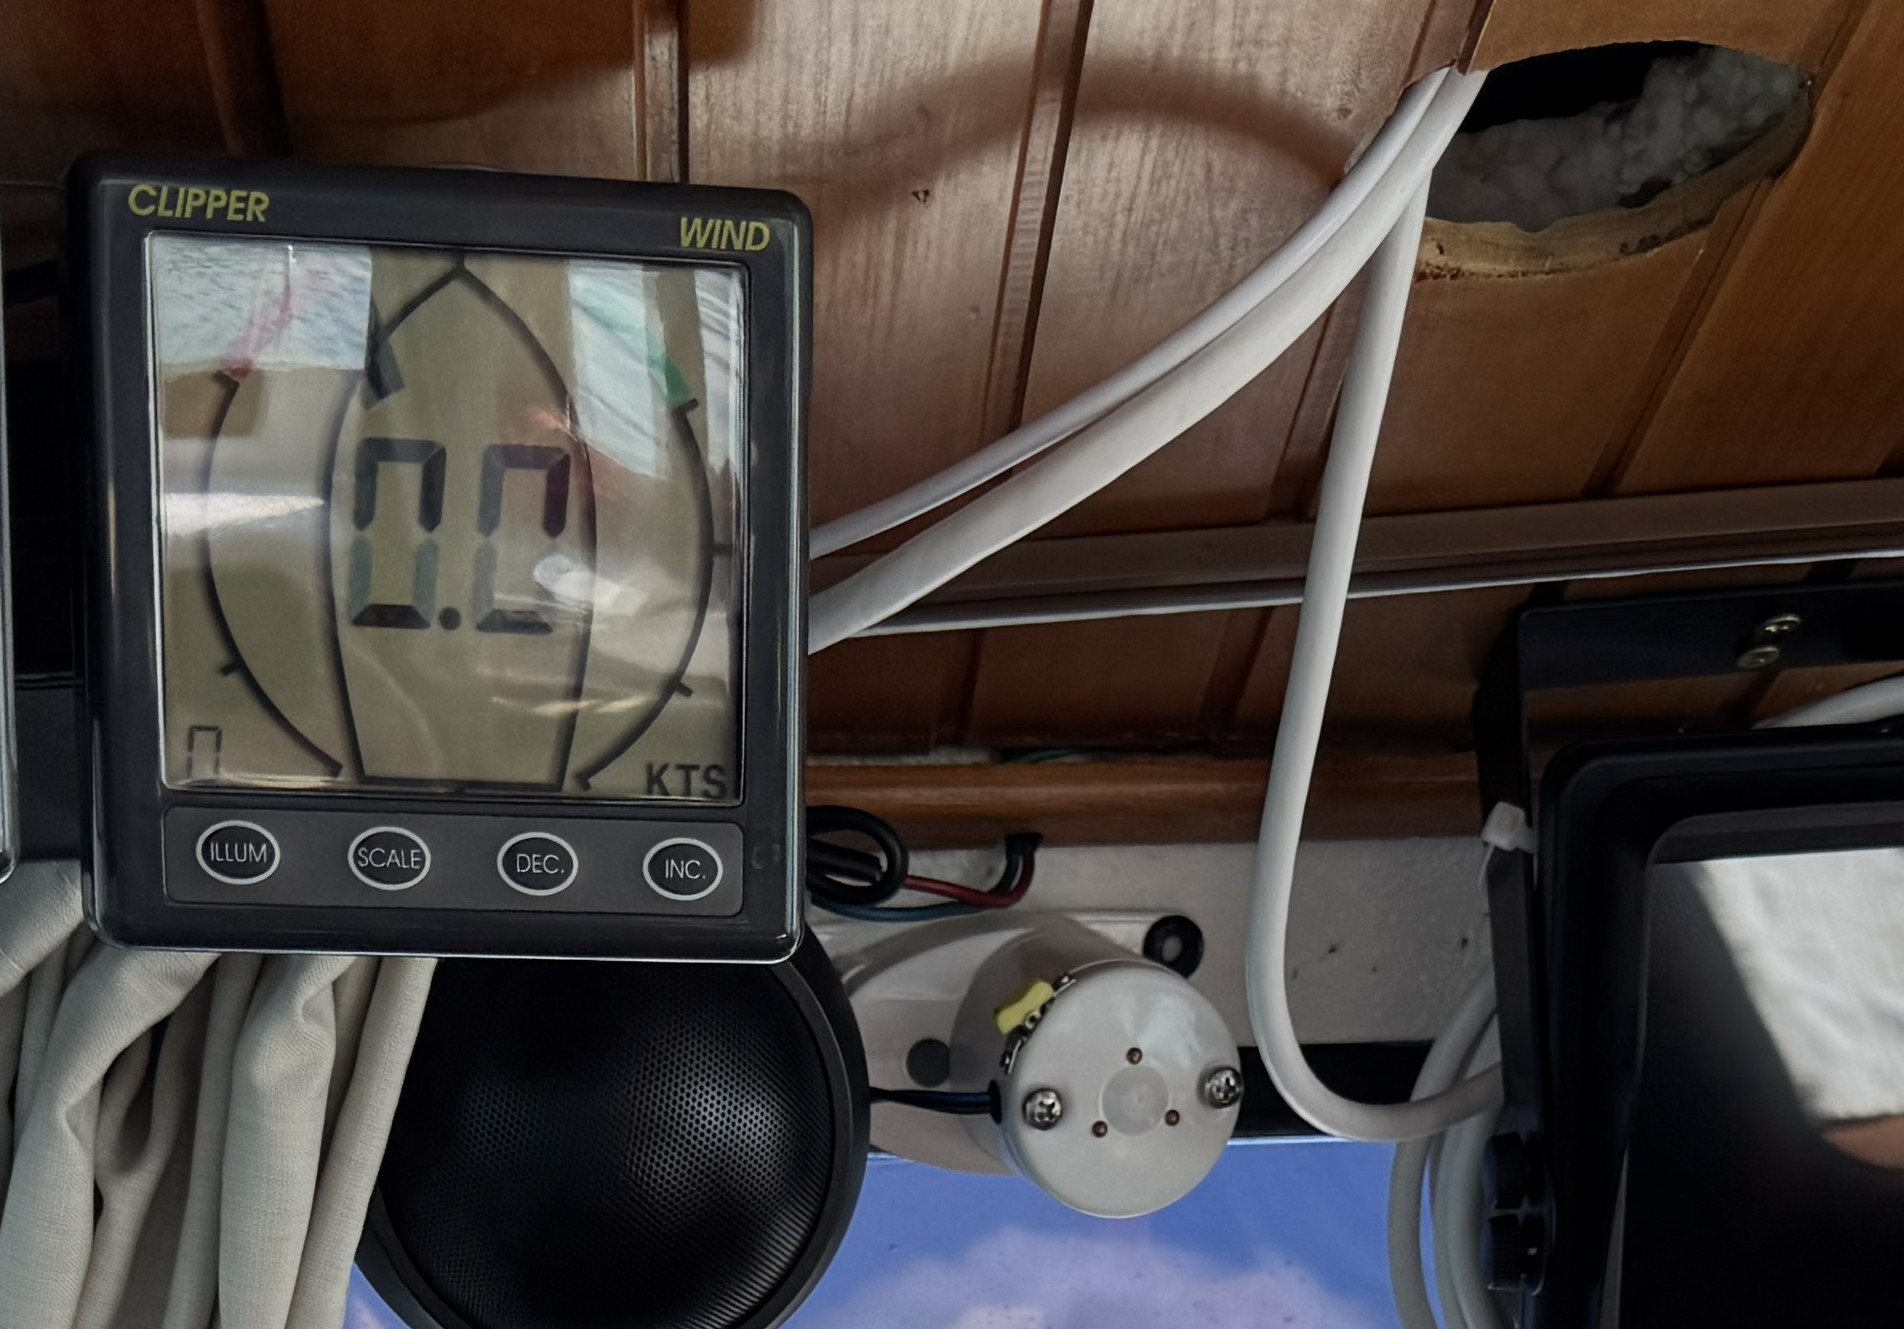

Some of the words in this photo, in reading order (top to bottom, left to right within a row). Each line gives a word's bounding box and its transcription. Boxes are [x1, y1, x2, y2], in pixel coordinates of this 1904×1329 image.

[127, 184, 271, 223] CLIPPER
[678, 217, 771, 252] WIND
[350, 437, 573, 636] 0.0
[645, 763, 727, 800] KTS
[209, 840, 268, 864] ILLUM
[357, 846, 422, 871] SCALE
[516, 852, 565, 874] DEC.
[664, 858, 706, 881] INC.
